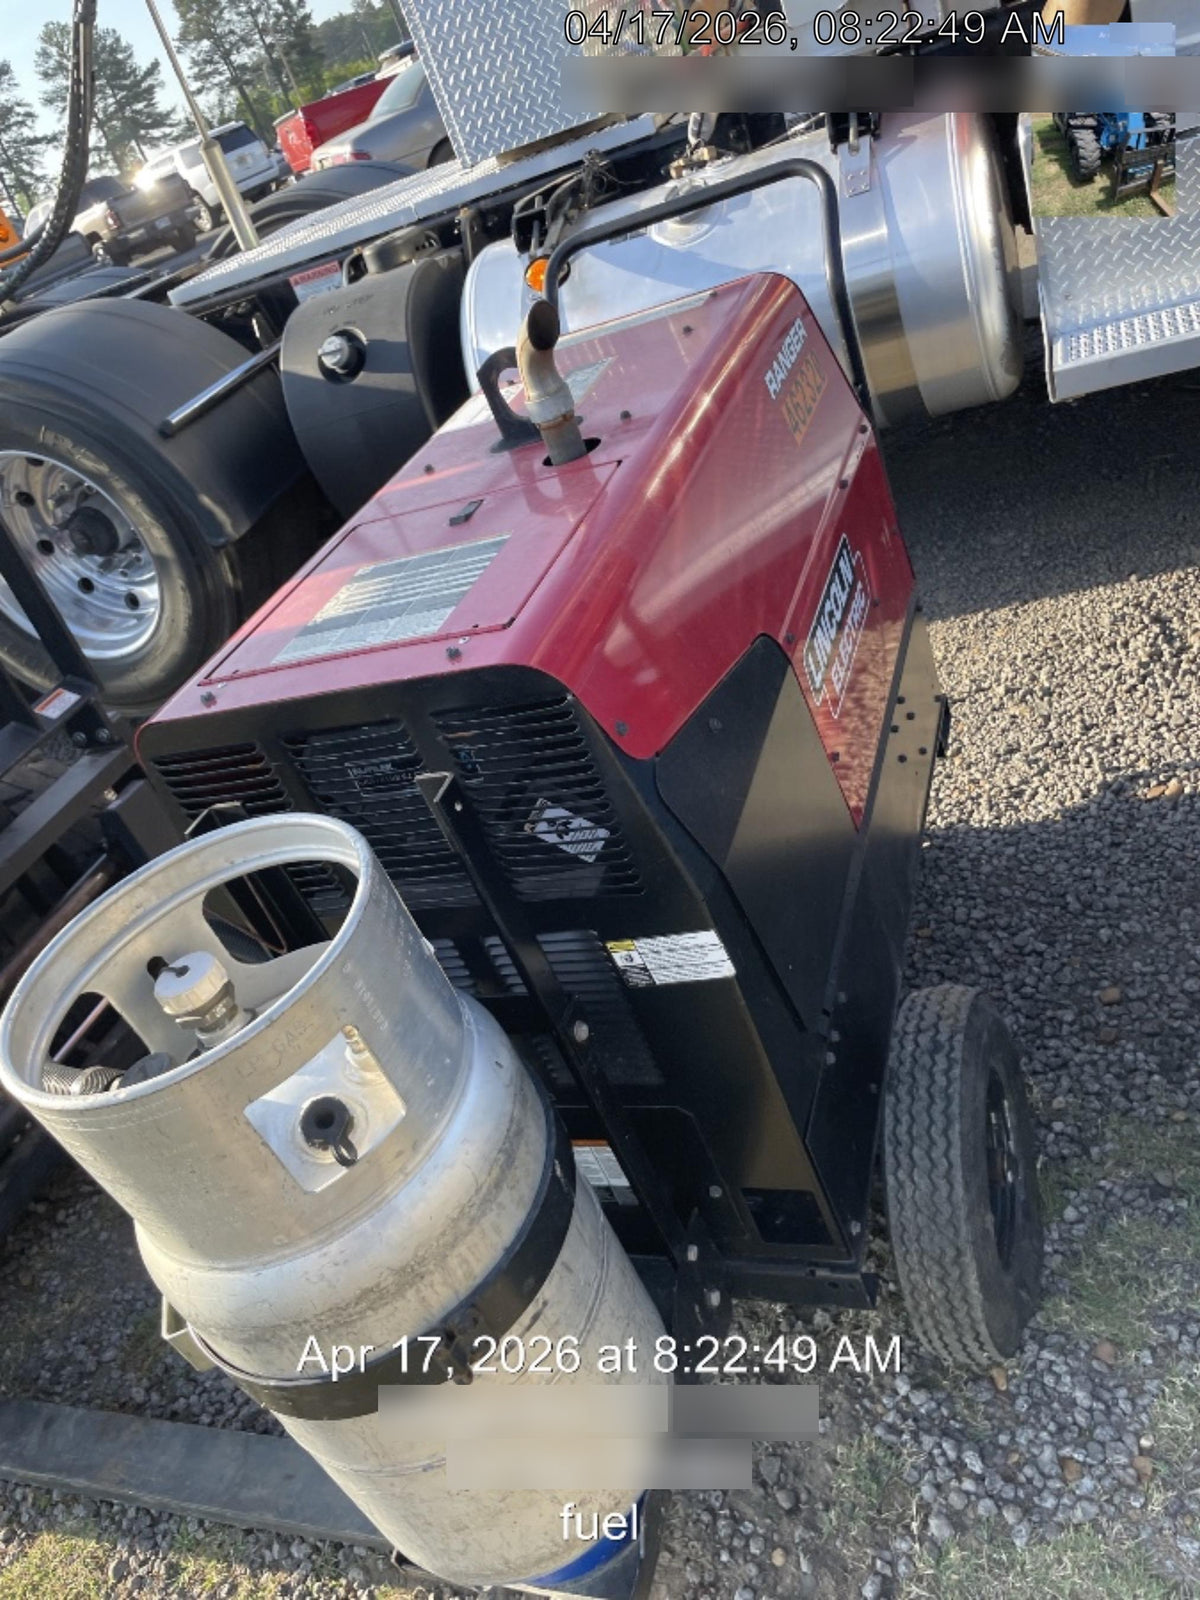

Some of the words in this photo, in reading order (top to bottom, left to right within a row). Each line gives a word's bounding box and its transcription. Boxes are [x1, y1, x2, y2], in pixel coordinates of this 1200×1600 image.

[764, 317, 807, 400] RANGER
[808, 548, 854, 690] LINCOLN
[831, 580, 866, 696] ELECTRIC
